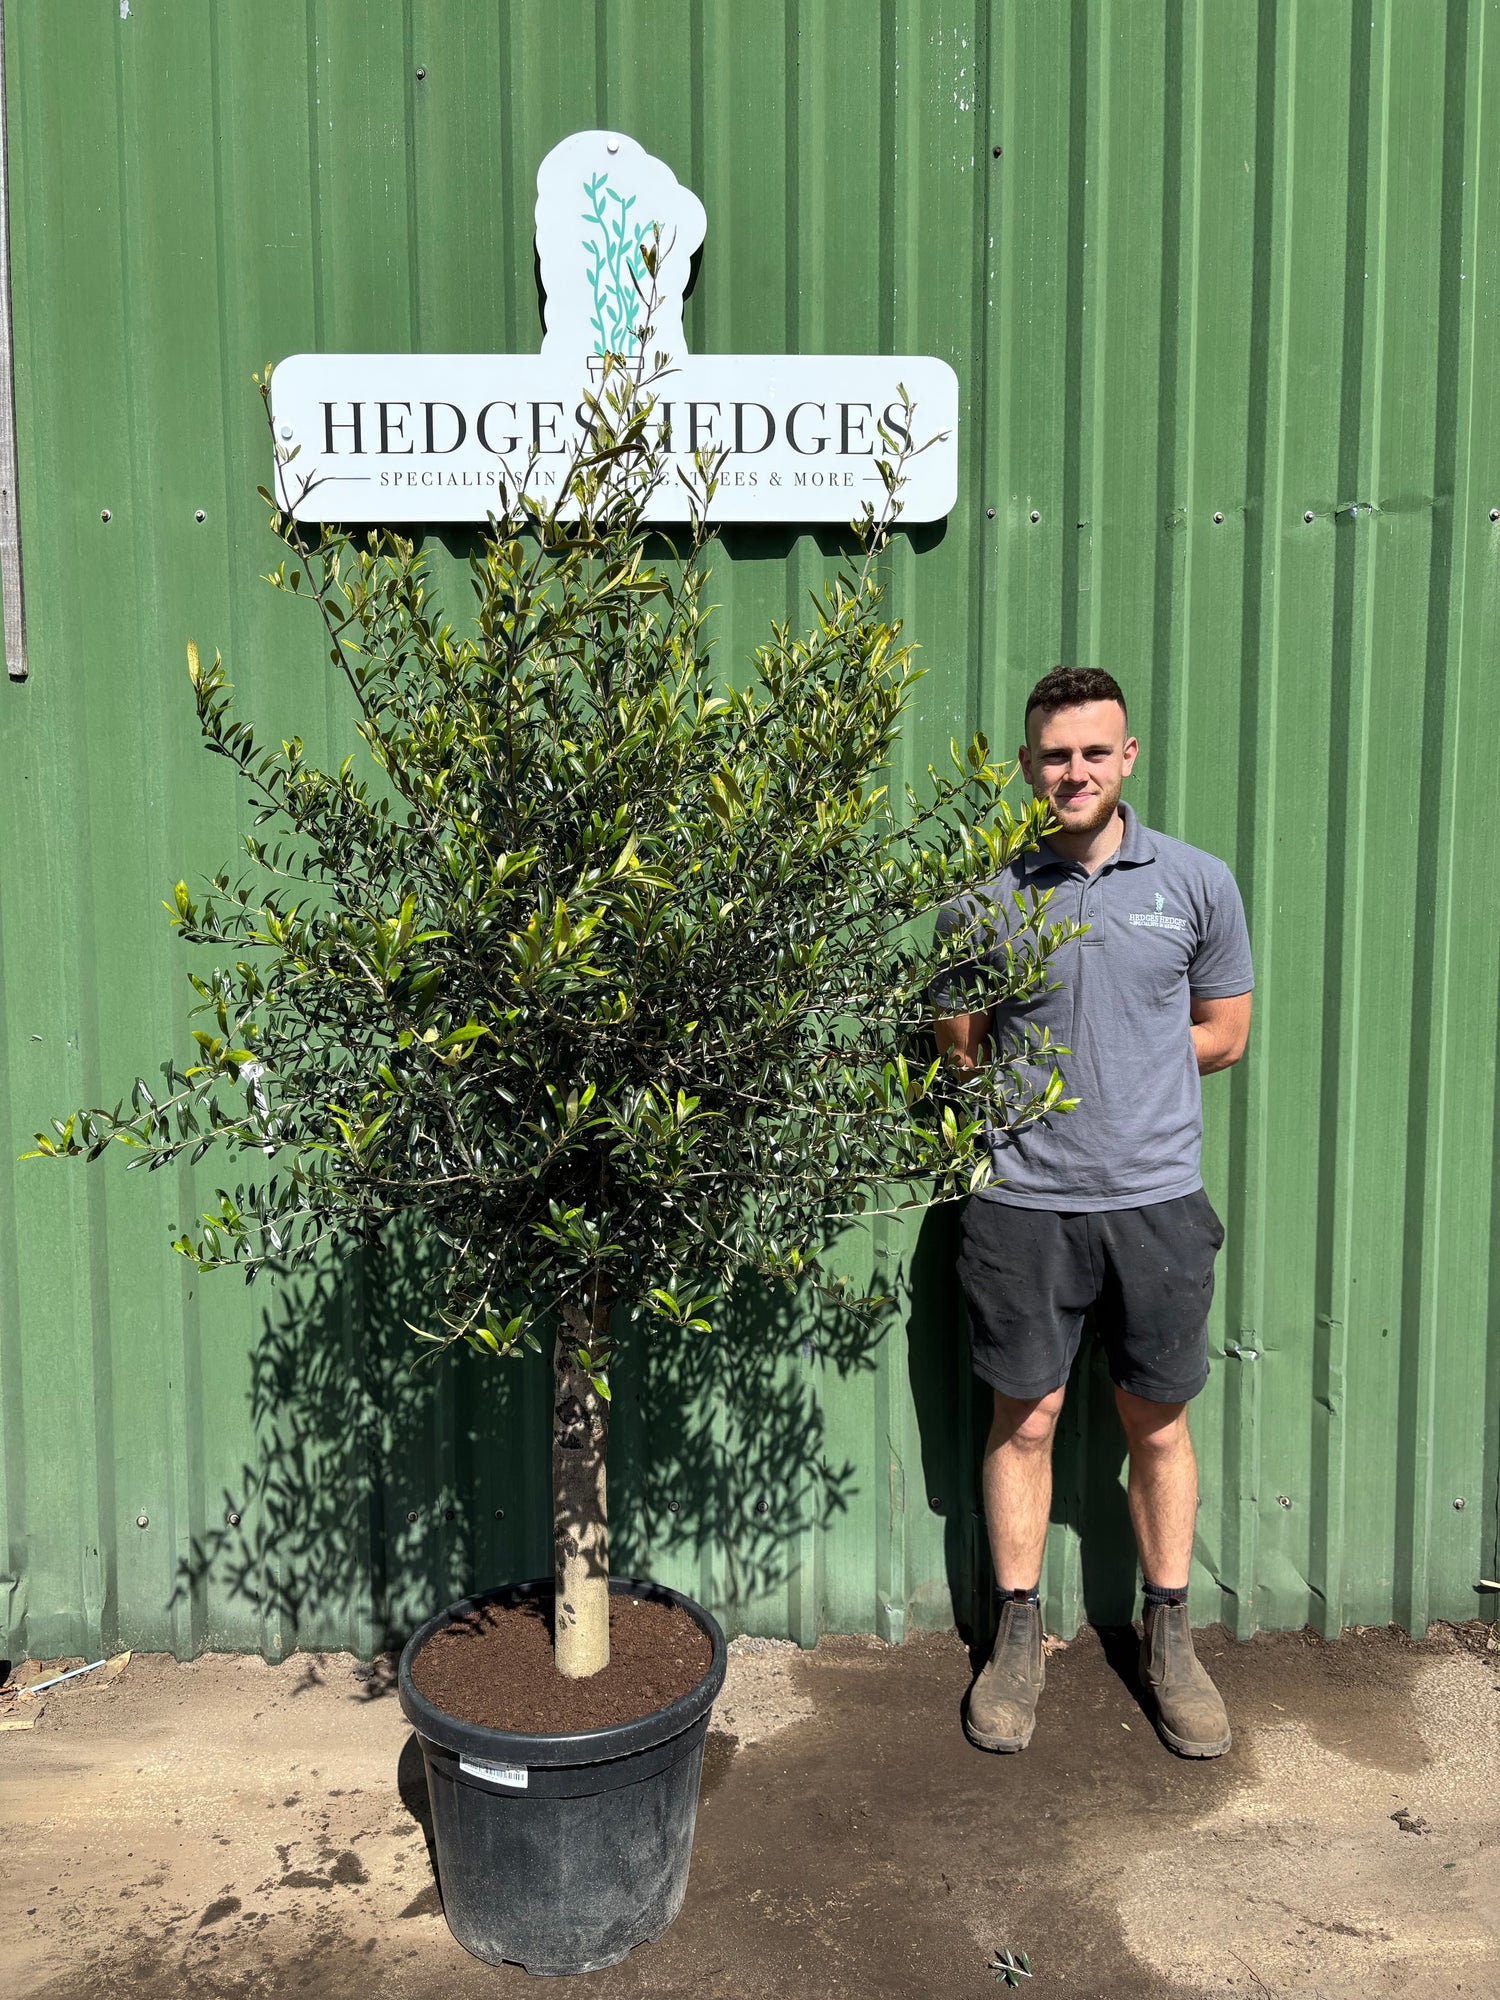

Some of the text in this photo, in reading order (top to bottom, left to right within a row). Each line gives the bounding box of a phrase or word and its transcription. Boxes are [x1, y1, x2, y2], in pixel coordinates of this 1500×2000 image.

[380, 471, 523, 487] SPECIALISTS
[535, 471, 556, 486] IN
[690, 471, 758, 487] TEES
[769, 471, 782, 487] &
[794, 471, 854, 488] MORE
